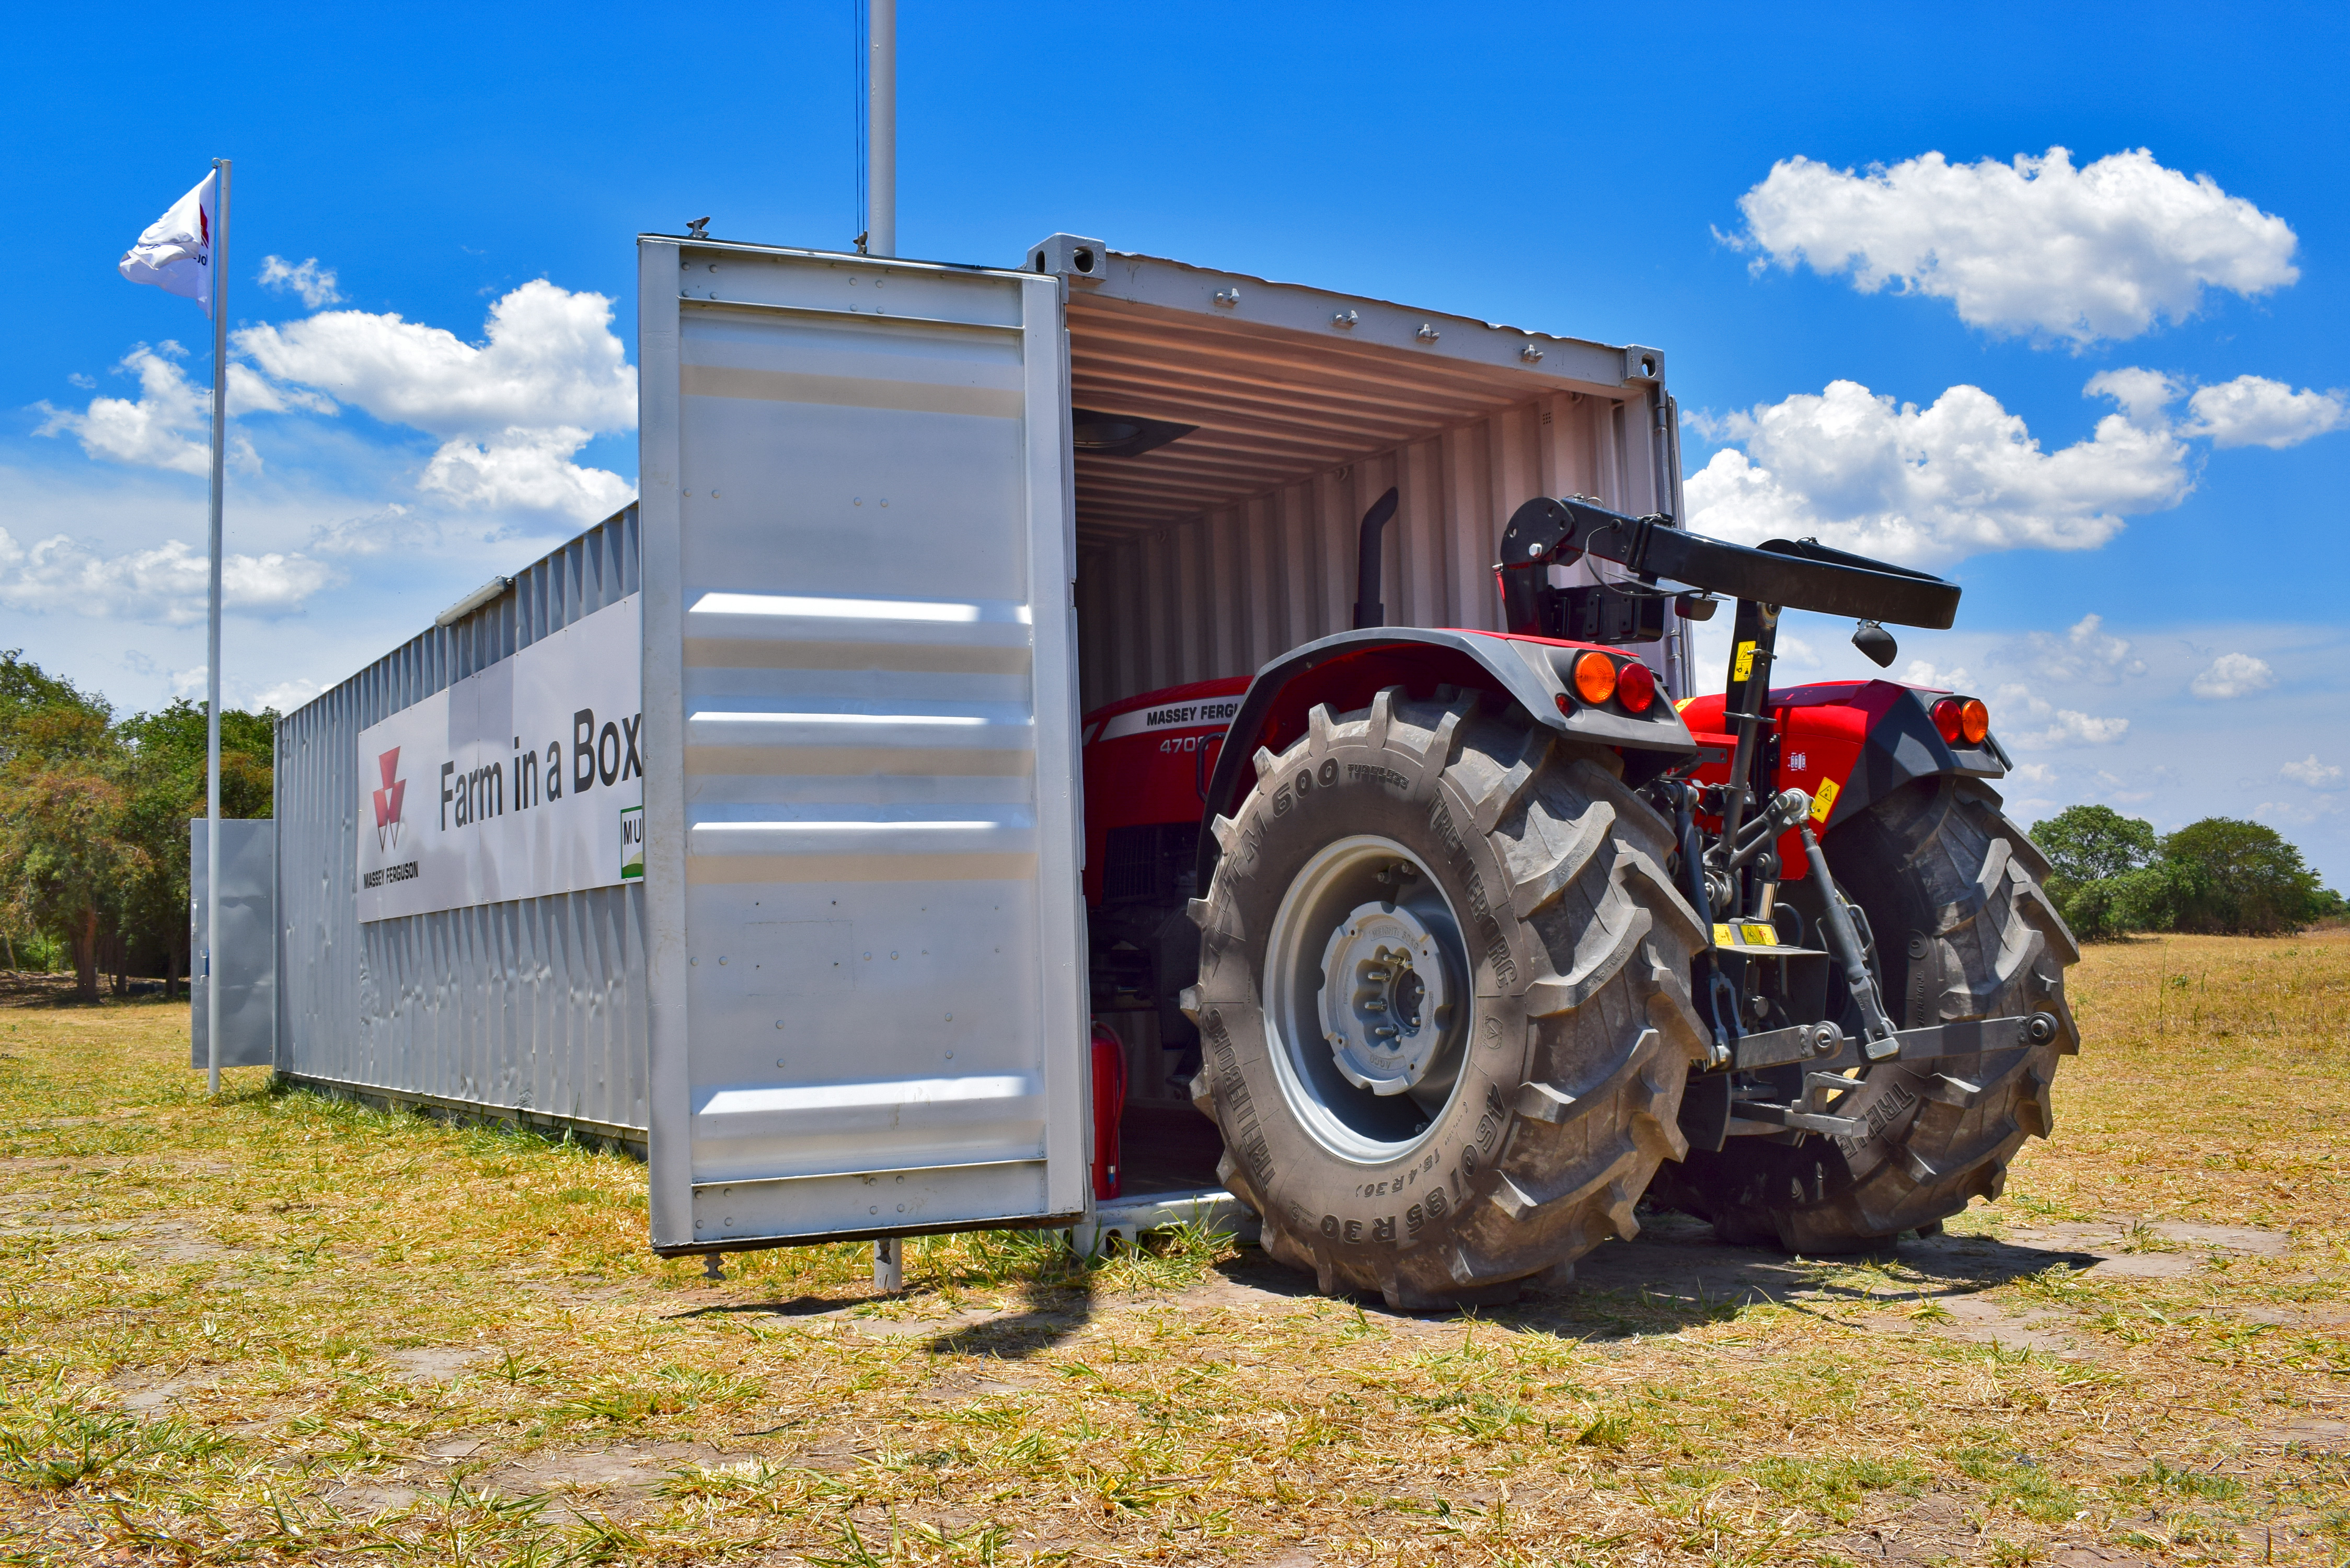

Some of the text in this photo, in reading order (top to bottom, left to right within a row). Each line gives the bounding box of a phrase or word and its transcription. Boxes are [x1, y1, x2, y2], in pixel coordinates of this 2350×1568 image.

[1147, 707, 1197, 726] MASSEY
[441, 708, 642, 831] Farm in a Box
[1272, 757, 1339, 817] 600
[1347, 763, 1410, 790] TUBELESS
[364, 860, 418, 889] MASSEY FERGUSON
[1205, 1008, 1276, 1192] TRELLEBORG
